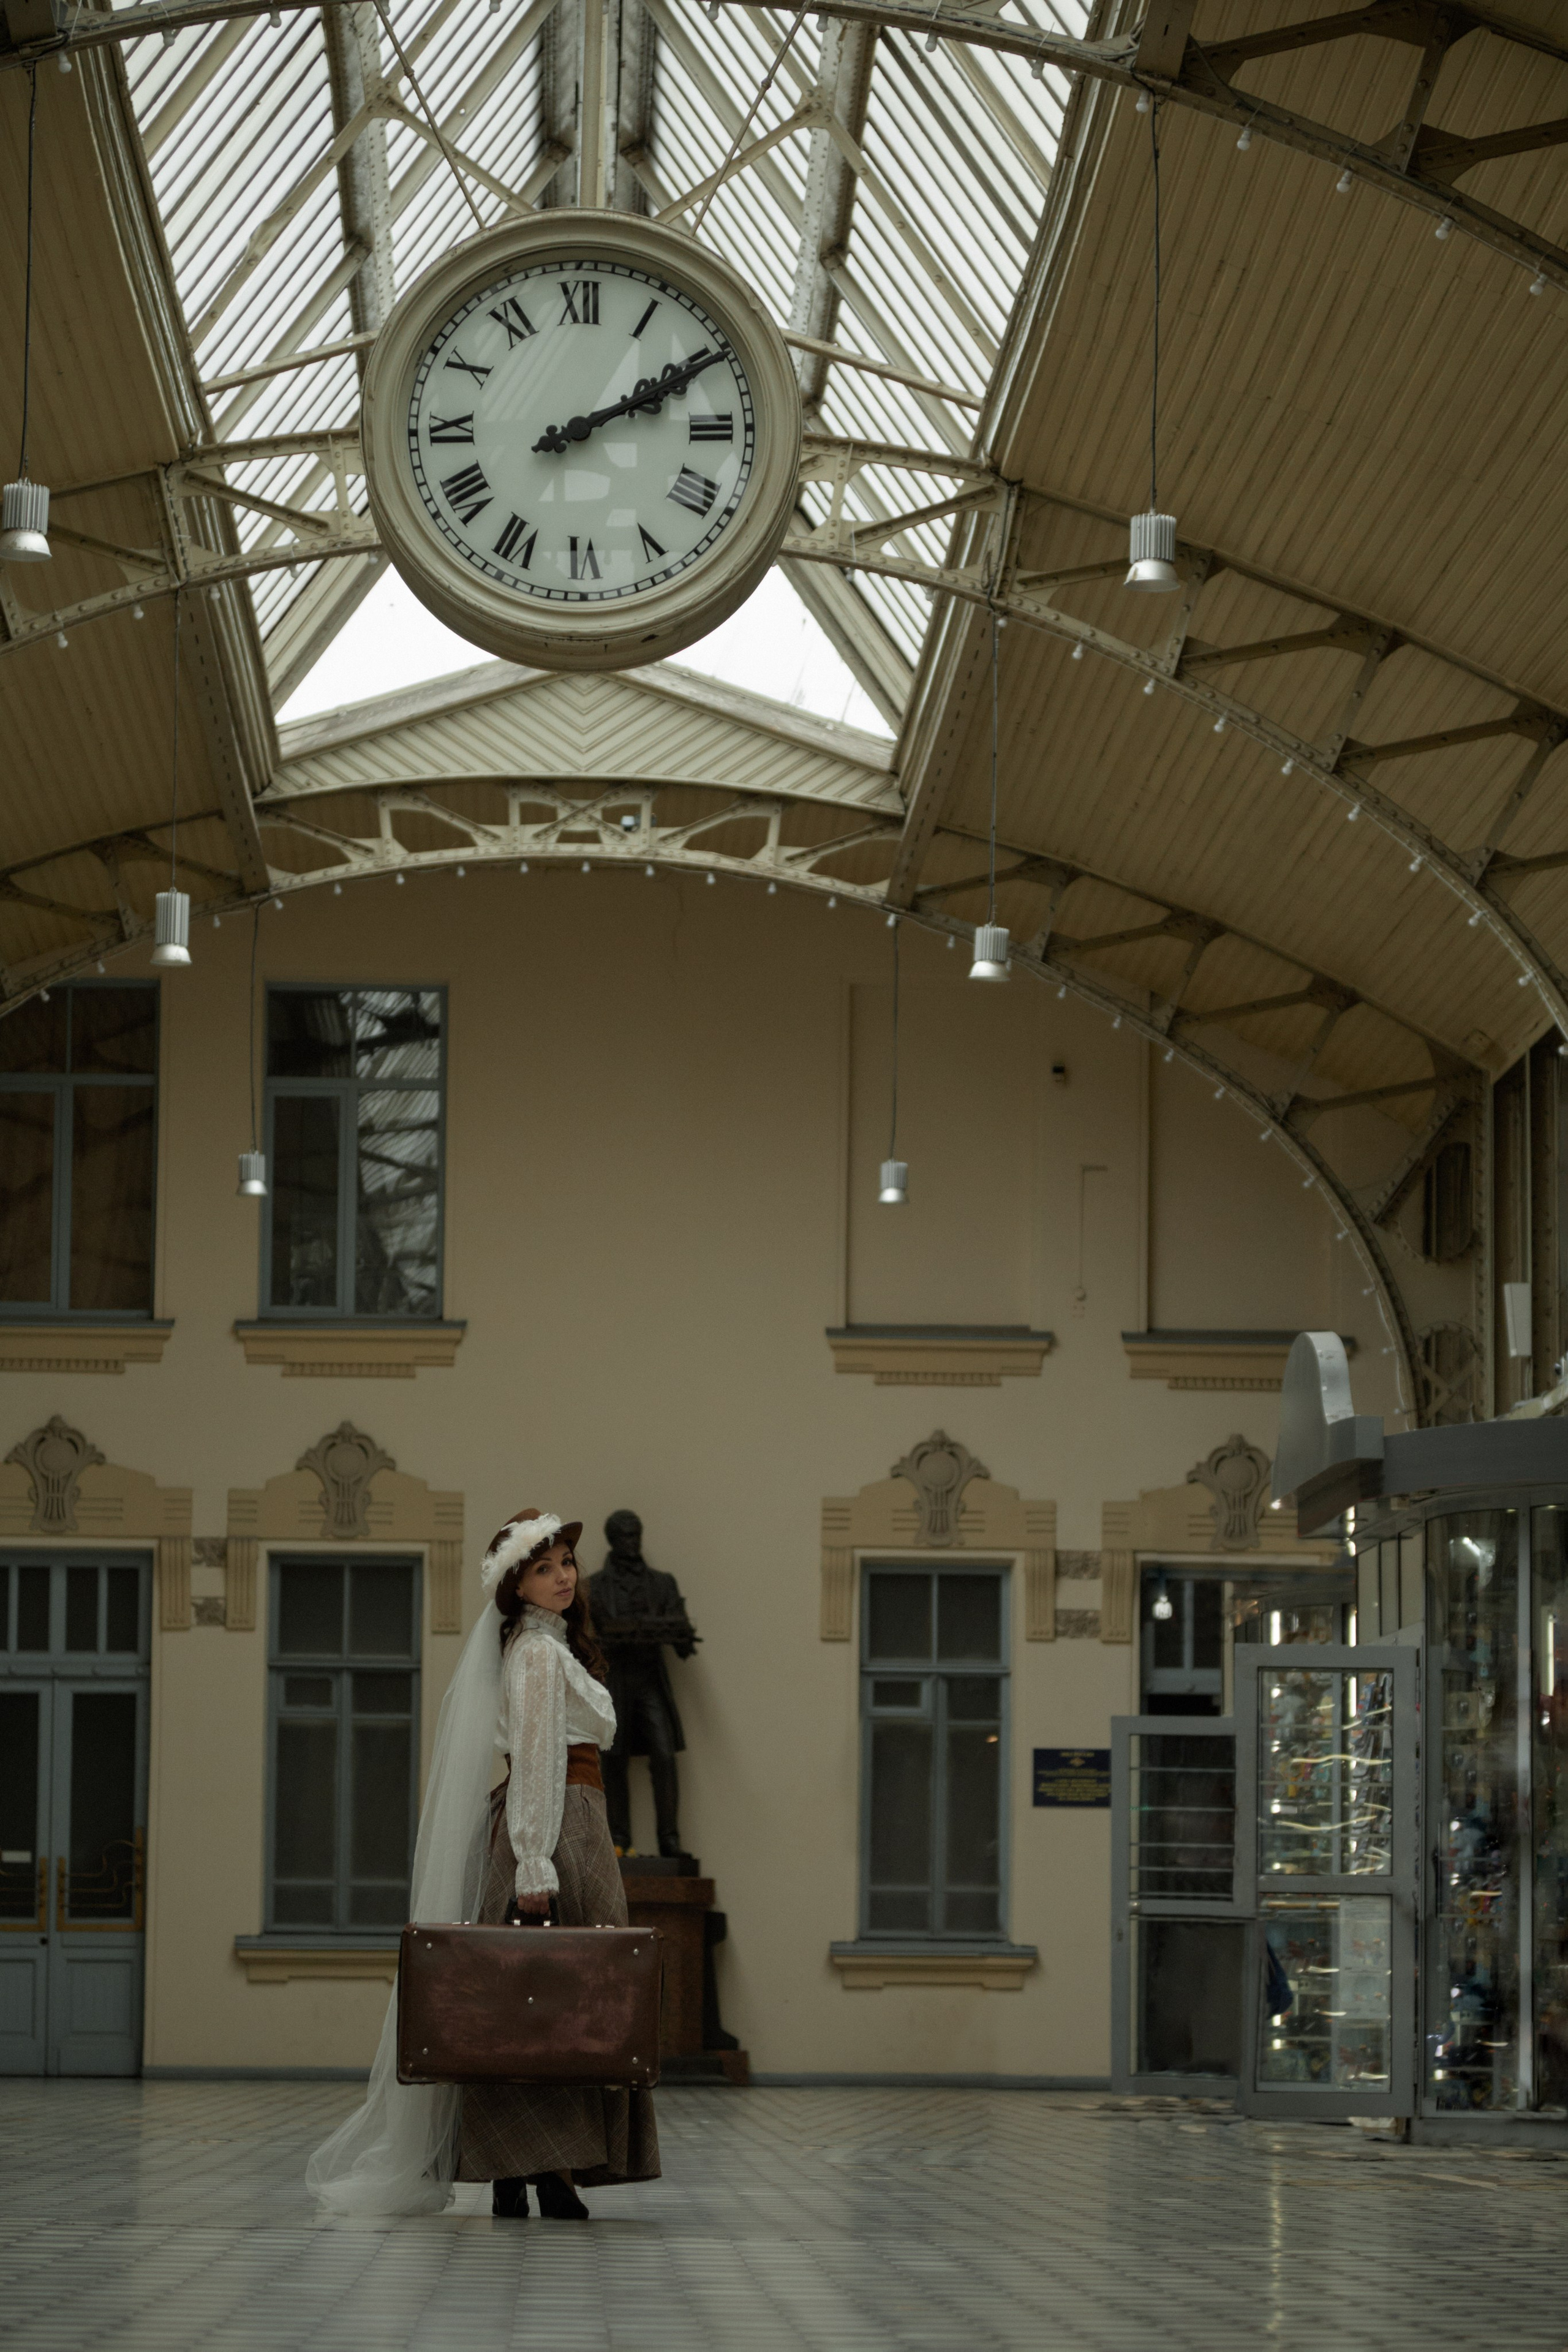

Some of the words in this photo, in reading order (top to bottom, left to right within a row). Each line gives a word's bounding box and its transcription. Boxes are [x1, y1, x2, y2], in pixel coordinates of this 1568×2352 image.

[487, 296, 539, 350] XI
[557, 281, 601, 325] XII
[628, 298, 662, 341] I
[444, 346, 494, 390] X
[429, 410, 475, 446] IX
[688, 411, 733, 445] III
[440, 460, 494, 527] VIII
[666, 463, 722, 519] IIII
[492, 511, 538, 570] VII
[568, 536, 603, 581] VI
[638, 522, 669, 563] V
